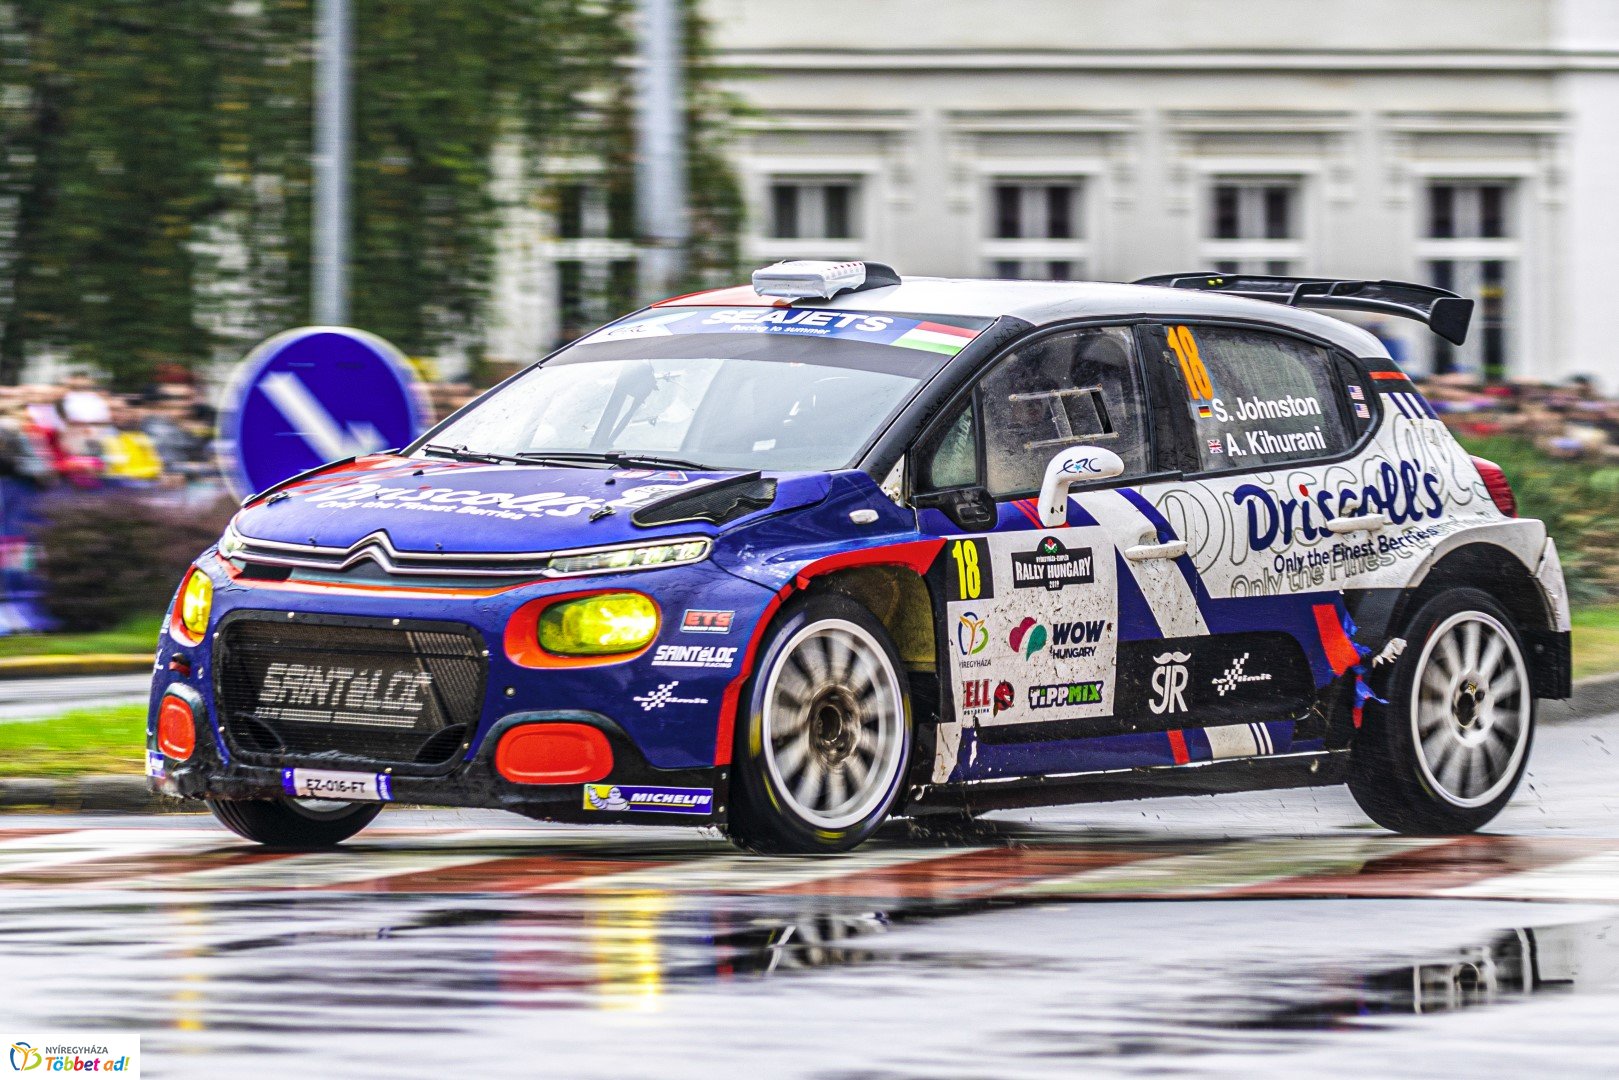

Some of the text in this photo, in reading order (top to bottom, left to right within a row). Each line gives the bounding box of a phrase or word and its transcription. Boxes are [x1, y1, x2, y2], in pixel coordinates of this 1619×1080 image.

[702, 310, 893, 332] SEAJETS
[784, 327, 831, 335] summer
[1167, 325, 1214, 401] 18
[1211, 394, 1322, 422] S. Johnston
[1225, 425, 1327, 457] A. Kihurani
[1233, 459, 1443, 551] Driscoll's
[1273, 553, 1304, 575] Only
[1307, 547, 1330, 566] the
[1332, 539, 1375, 563] Finest
[1378, 524, 1439, 553] Berries
[951, 539, 981, 600] 18
[1015, 561, 1044, 581] RALLY
[1047, 556, 1091, 579] HUNGARY
[684, 611, 731, 627] ETS
[1052, 620, 1105, 646] WOW
[1052, 646, 1097, 659] HUNGARY
[306, 778, 366, 794] EZ-016-FT
[630, 793, 711, 805] MICHELIN
